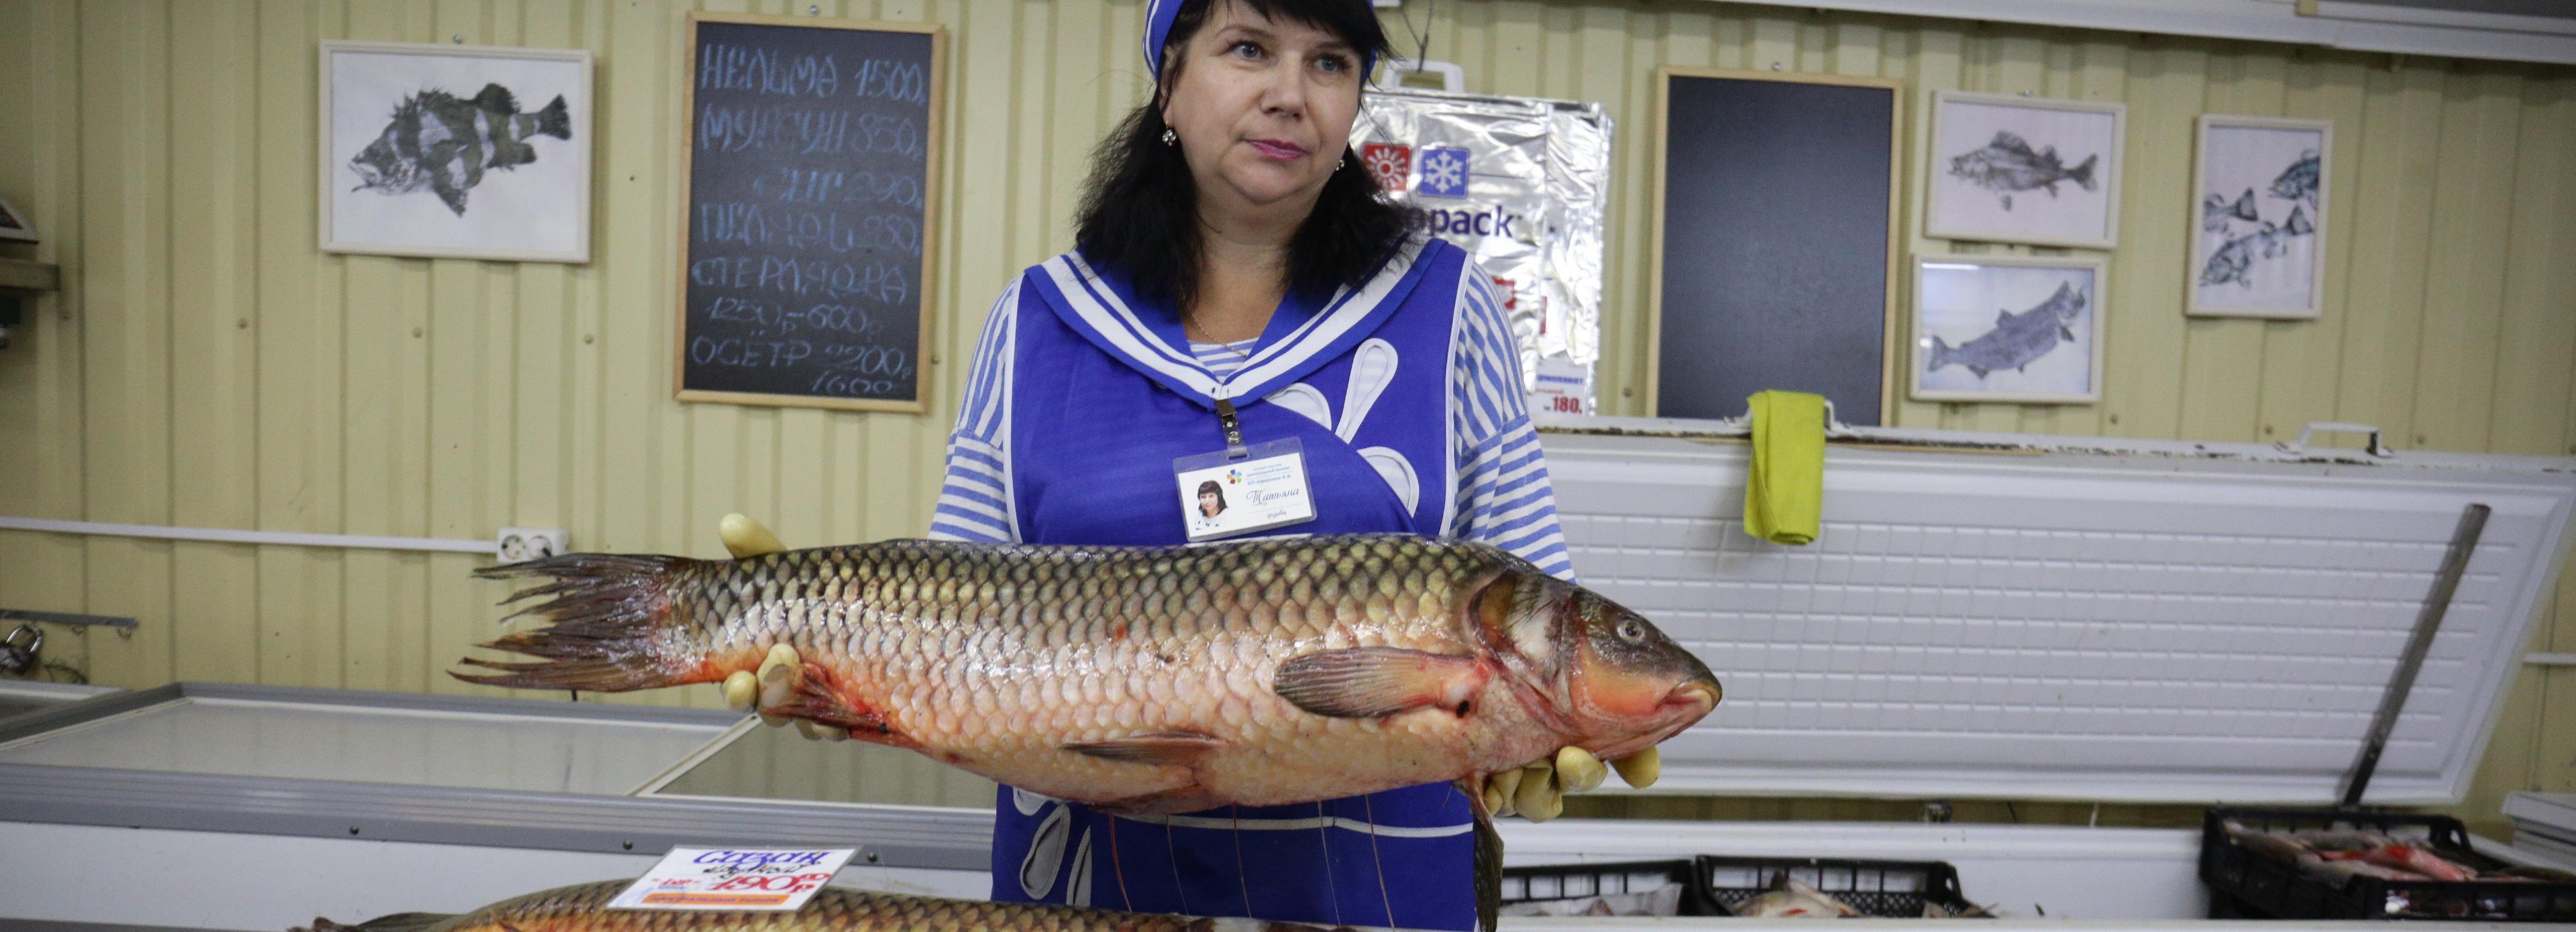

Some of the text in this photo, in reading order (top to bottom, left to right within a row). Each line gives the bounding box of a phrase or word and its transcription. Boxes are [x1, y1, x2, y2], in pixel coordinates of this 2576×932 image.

[700, 43, 838, 98] НЕЛЬМА
[1413, 205, 1514, 237] pack
[1246, 487, 1299, 506] Татьяна
